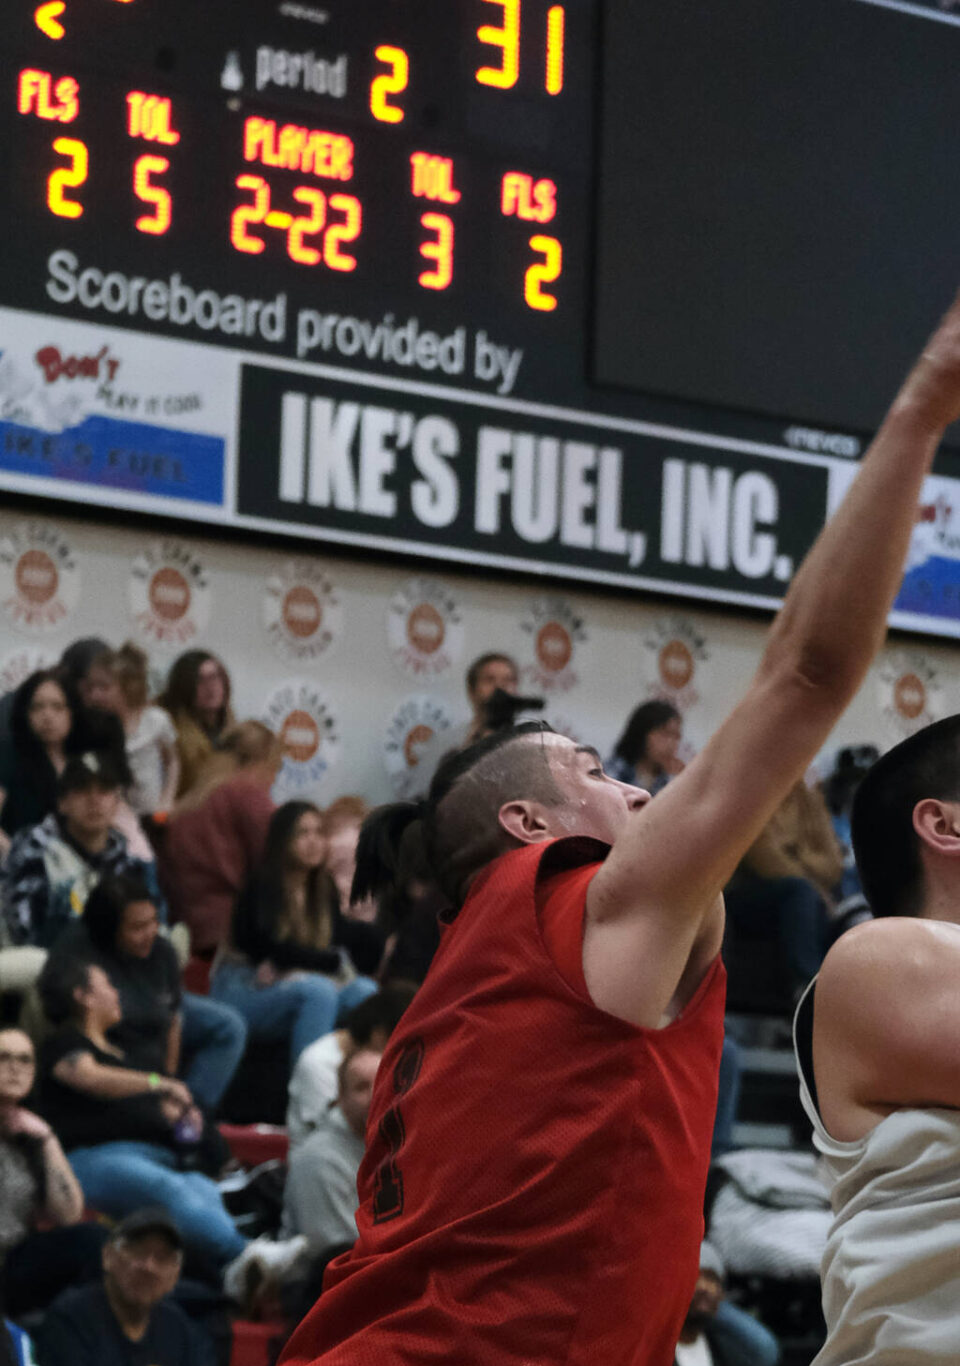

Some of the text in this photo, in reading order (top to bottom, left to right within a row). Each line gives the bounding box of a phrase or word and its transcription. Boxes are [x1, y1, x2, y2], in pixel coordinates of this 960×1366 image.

[256, 44, 347, 98] period
[370, 44, 409, 124] 2
[475, 0, 565, 95] 31
[17, 68, 79, 123] FLS
[126, 90, 180, 145] TOL
[47, 137, 89, 219] 2
[244, 116, 354, 181] PLAYER
[410, 151, 461, 204] TOL
[133, 155, 172, 235] 5
[230, 173, 362, 272] 2-22
[501, 171, 558, 223] FLS
[418, 212, 454, 291] 3
[523, 234, 562, 312] 2
[46, 249, 523, 394] Scoreboard provided by
[279, 391, 795, 583] IKE'S FUEL, INC.
